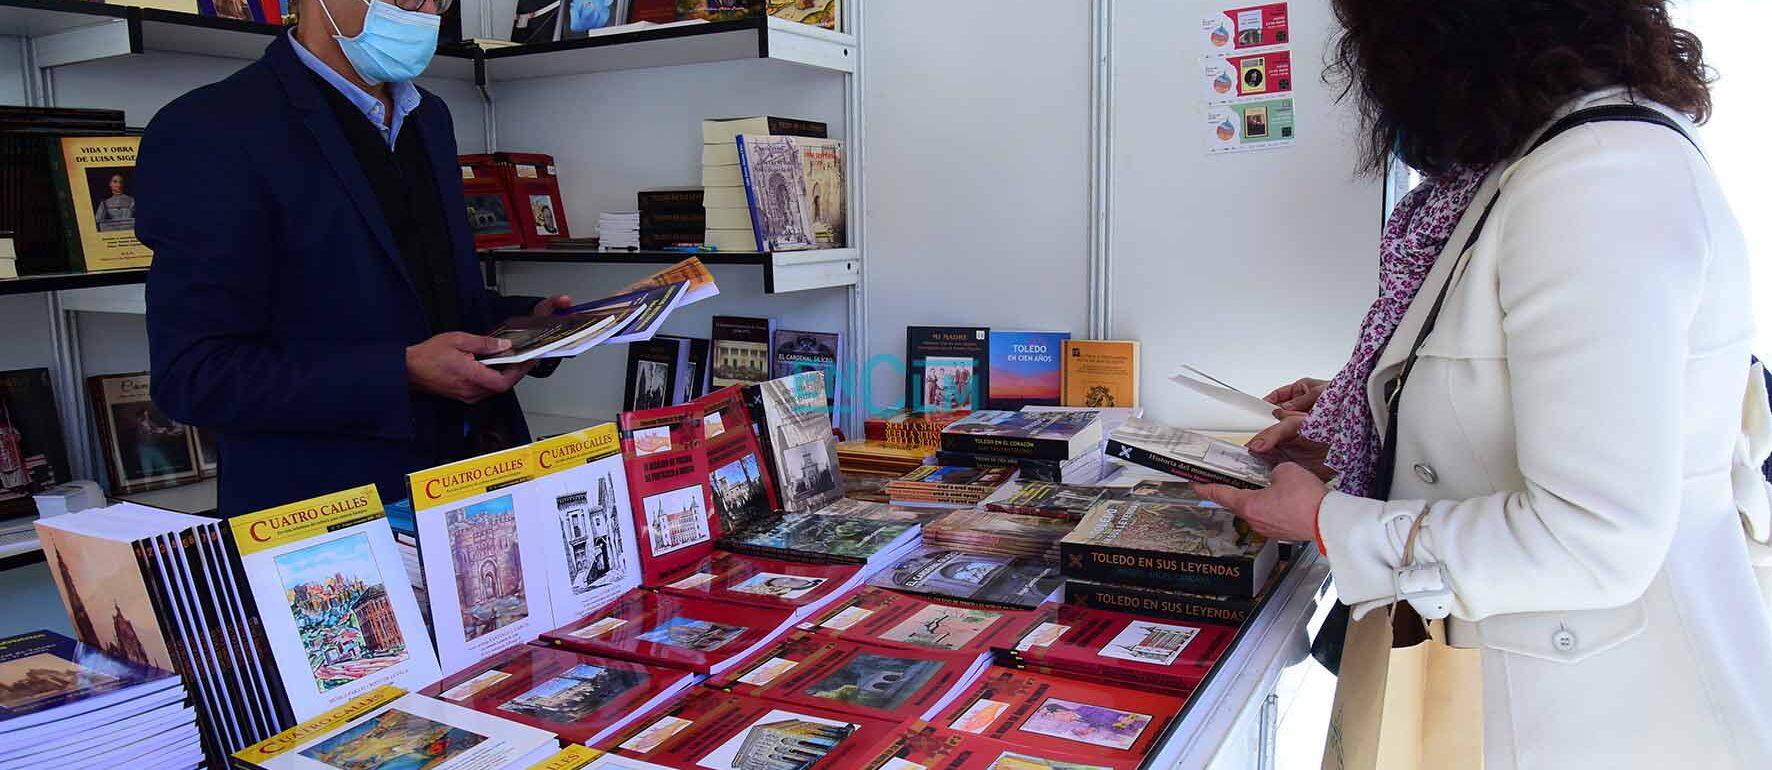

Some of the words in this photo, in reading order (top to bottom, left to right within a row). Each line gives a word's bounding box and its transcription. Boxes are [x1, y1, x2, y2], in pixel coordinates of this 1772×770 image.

[1013, 344, 1047, 353] TOLEDO
[1034, 354, 1052, 363] AÑOS
[538, 443, 581, 470] CUATRO
[581, 433, 612, 453] CALLES
[1149, 453, 1178, 469] Historia
[425, 465, 482, 499] CUATRO
[484, 458, 524, 480] CALLES
[249, 508, 318, 543] CUATRO
[320, 495, 369, 520] CALLES
[1090, 552, 1135, 567] TOLEDO
[1138, 556, 1153, 568] EN
[1156, 558, 1177, 571] SUS
[1180, 561, 1240, 578] LEYENDAS
[1095, 592, 1141, 607] TOLEDO
[1143, 598, 1159, 611] EN
[1161, 600, 1183, 614] SUS
[1185, 603, 1246, 622] LEYENDAS
